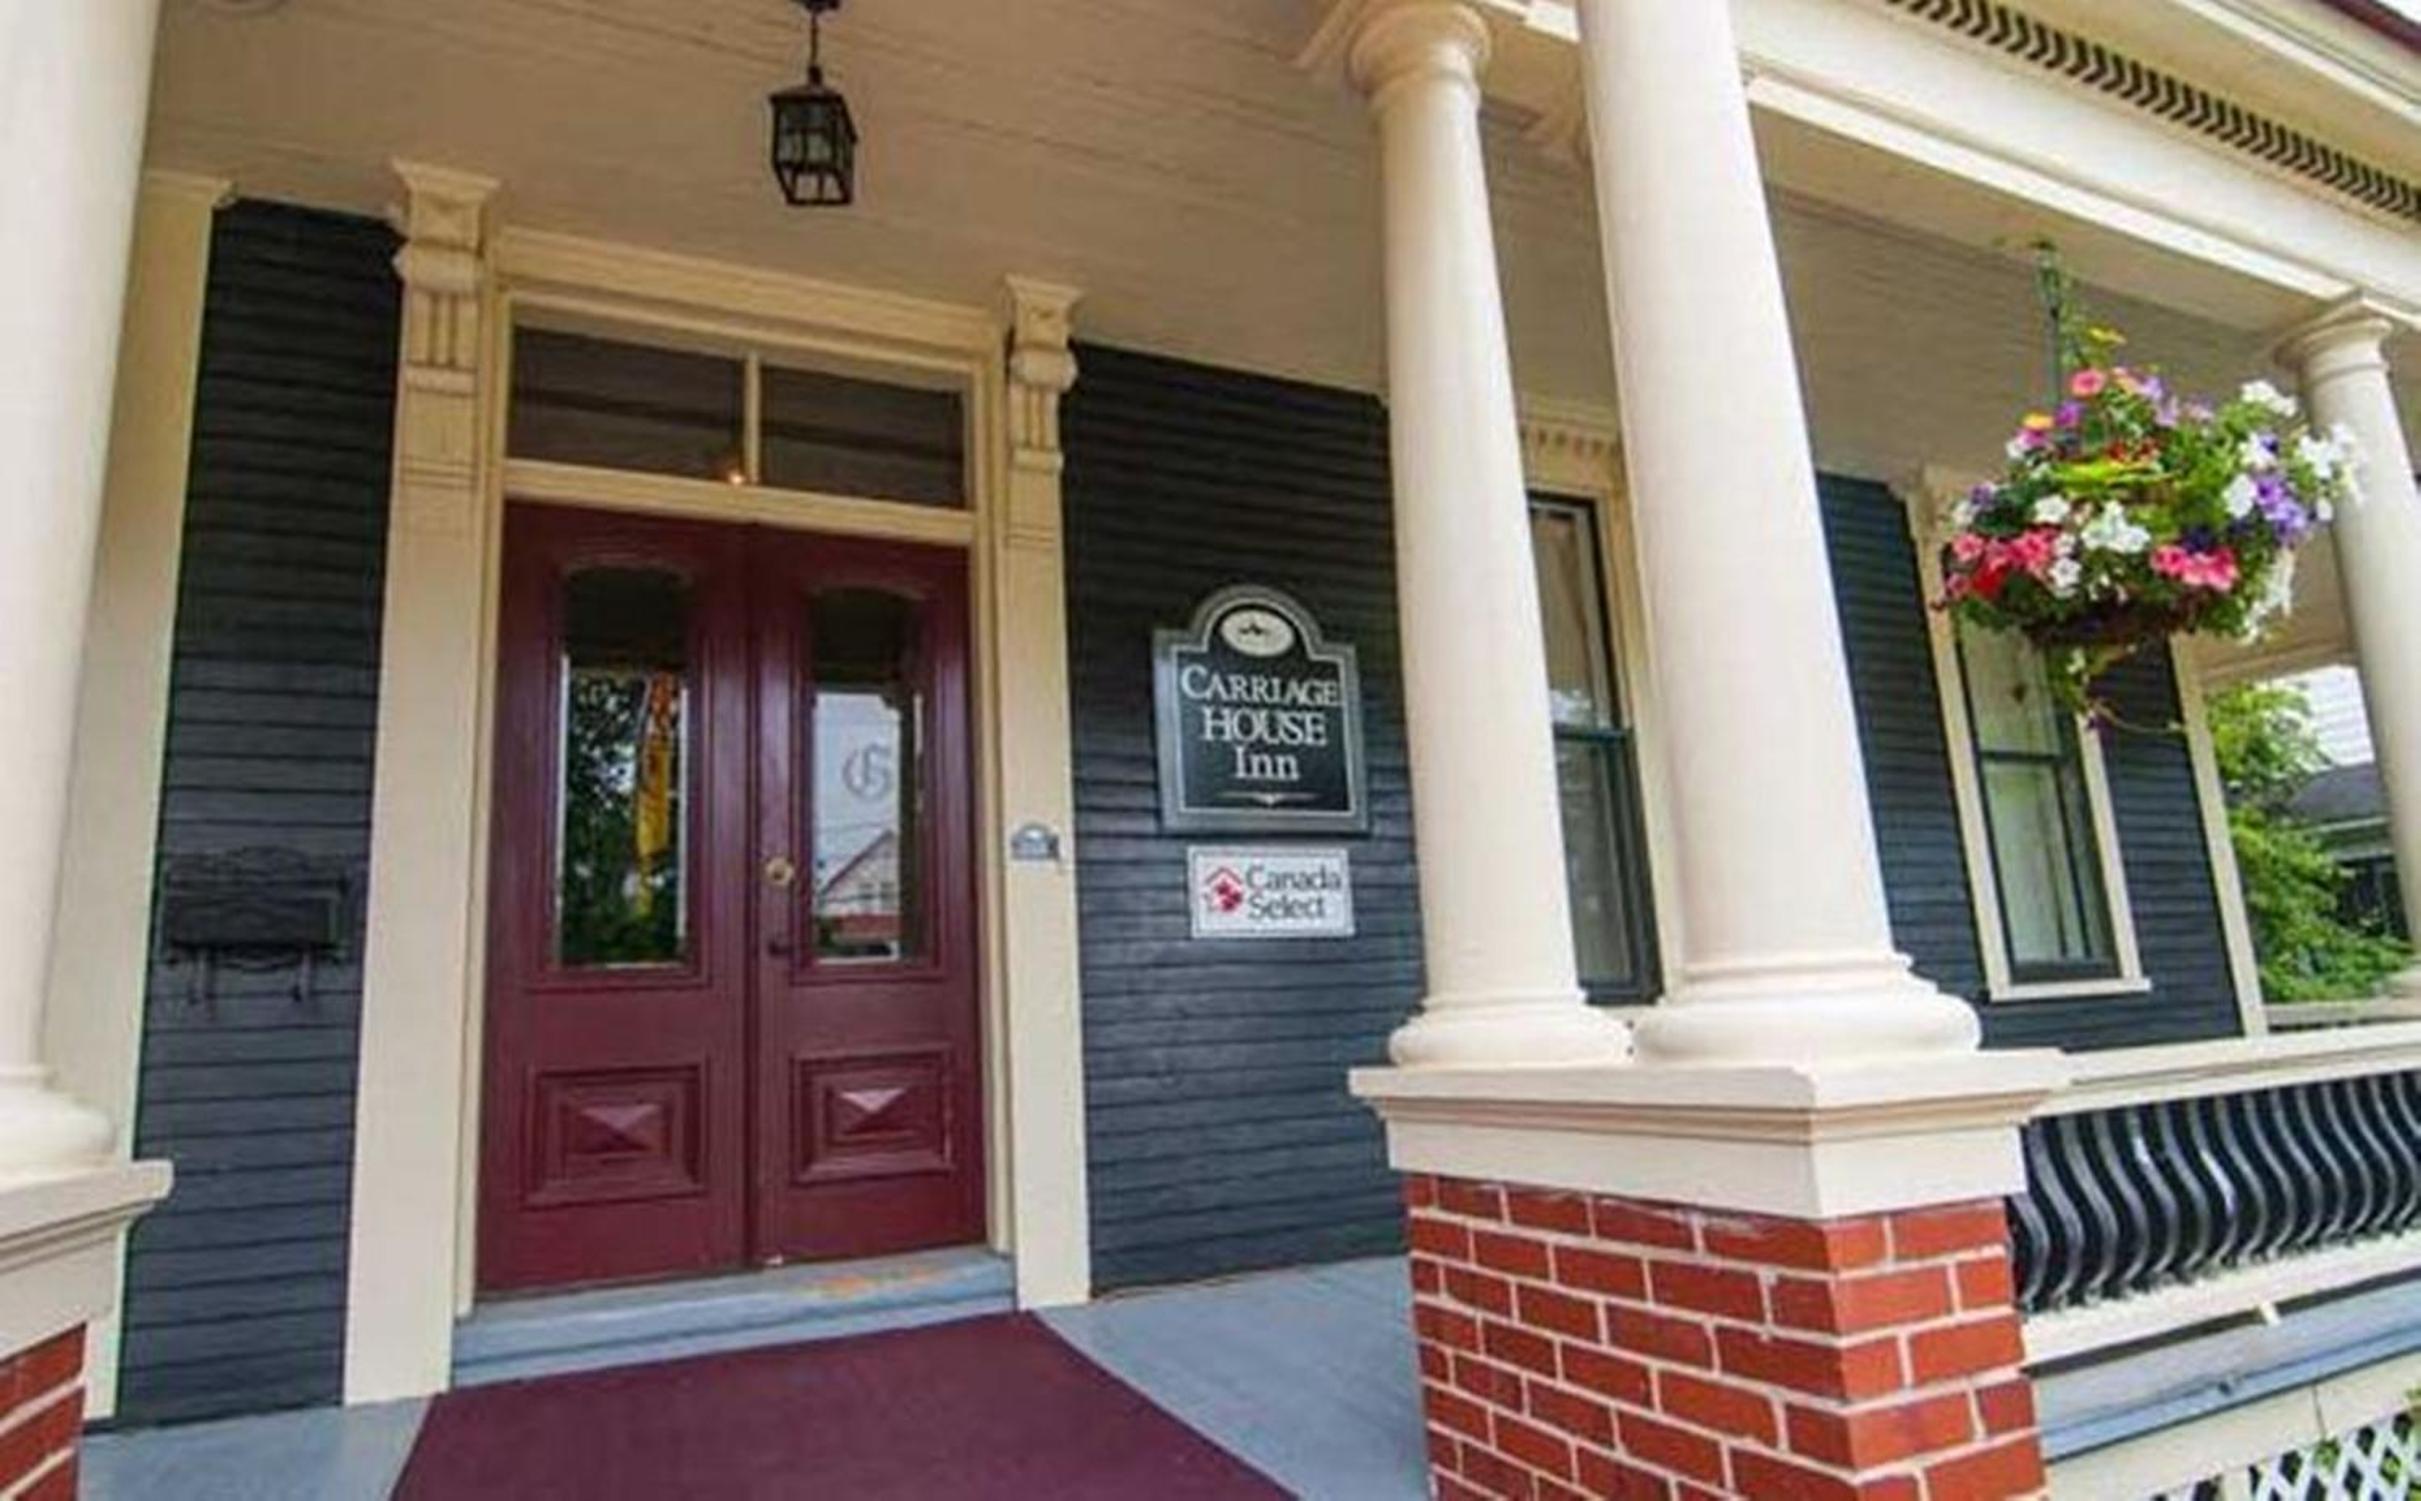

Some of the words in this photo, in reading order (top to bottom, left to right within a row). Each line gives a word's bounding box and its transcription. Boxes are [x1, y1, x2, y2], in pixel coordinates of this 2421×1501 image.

[1182, 664, 1338, 706] CARRIAGE
[1203, 707, 1327, 746] HOUSE
[1234, 747, 1300, 780] Inn
[1246, 864, 1341, 891] Canada
[1248, 895, 1326, 919] Select
